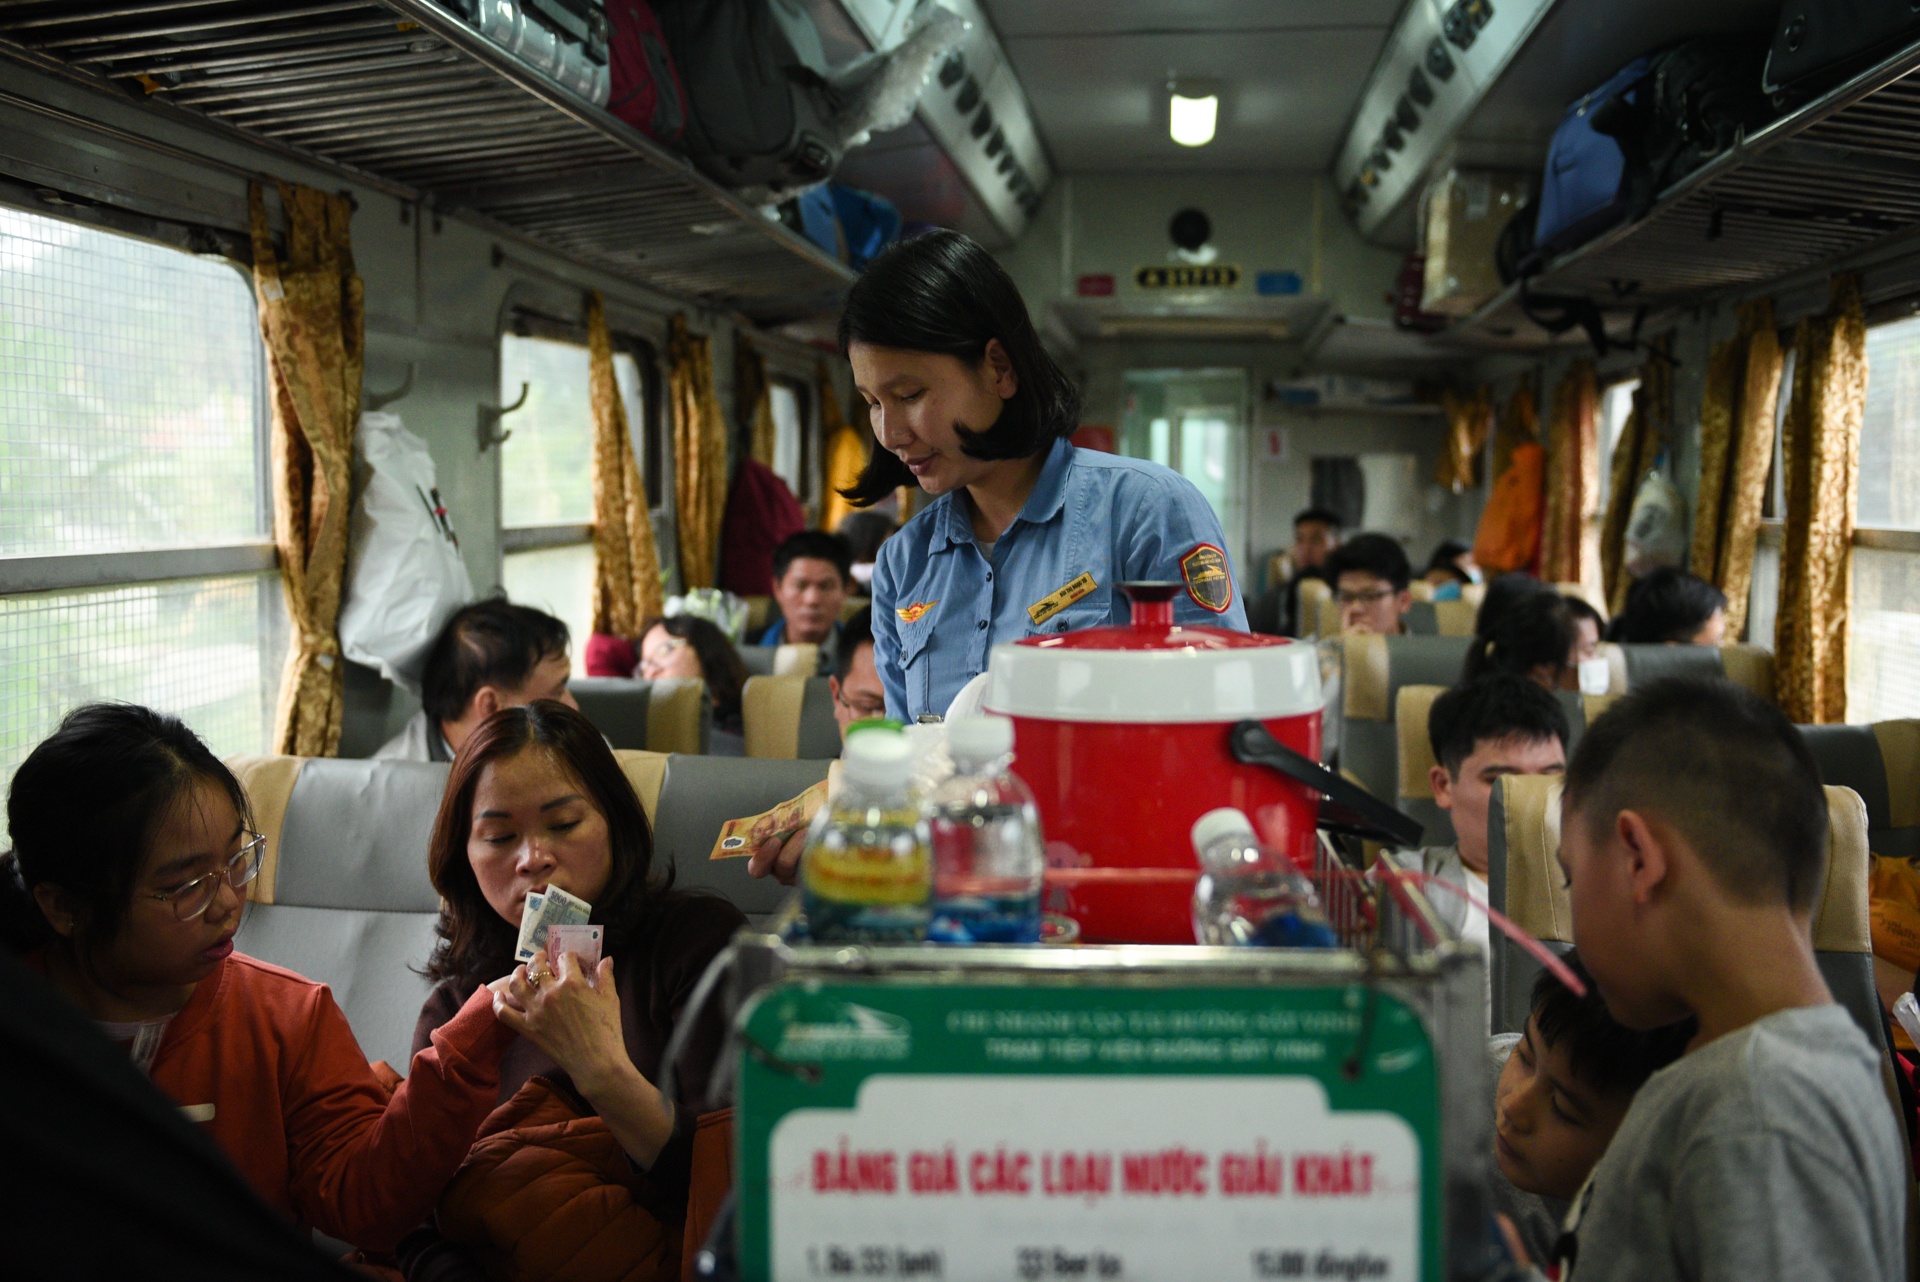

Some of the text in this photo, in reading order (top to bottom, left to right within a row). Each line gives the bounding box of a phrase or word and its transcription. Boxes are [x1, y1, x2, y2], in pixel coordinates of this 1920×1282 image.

[812, 1136, 1374, 1209] BẢNG GIÁ CÁC LOẠI NƯỚC GIẢI KHÁT
